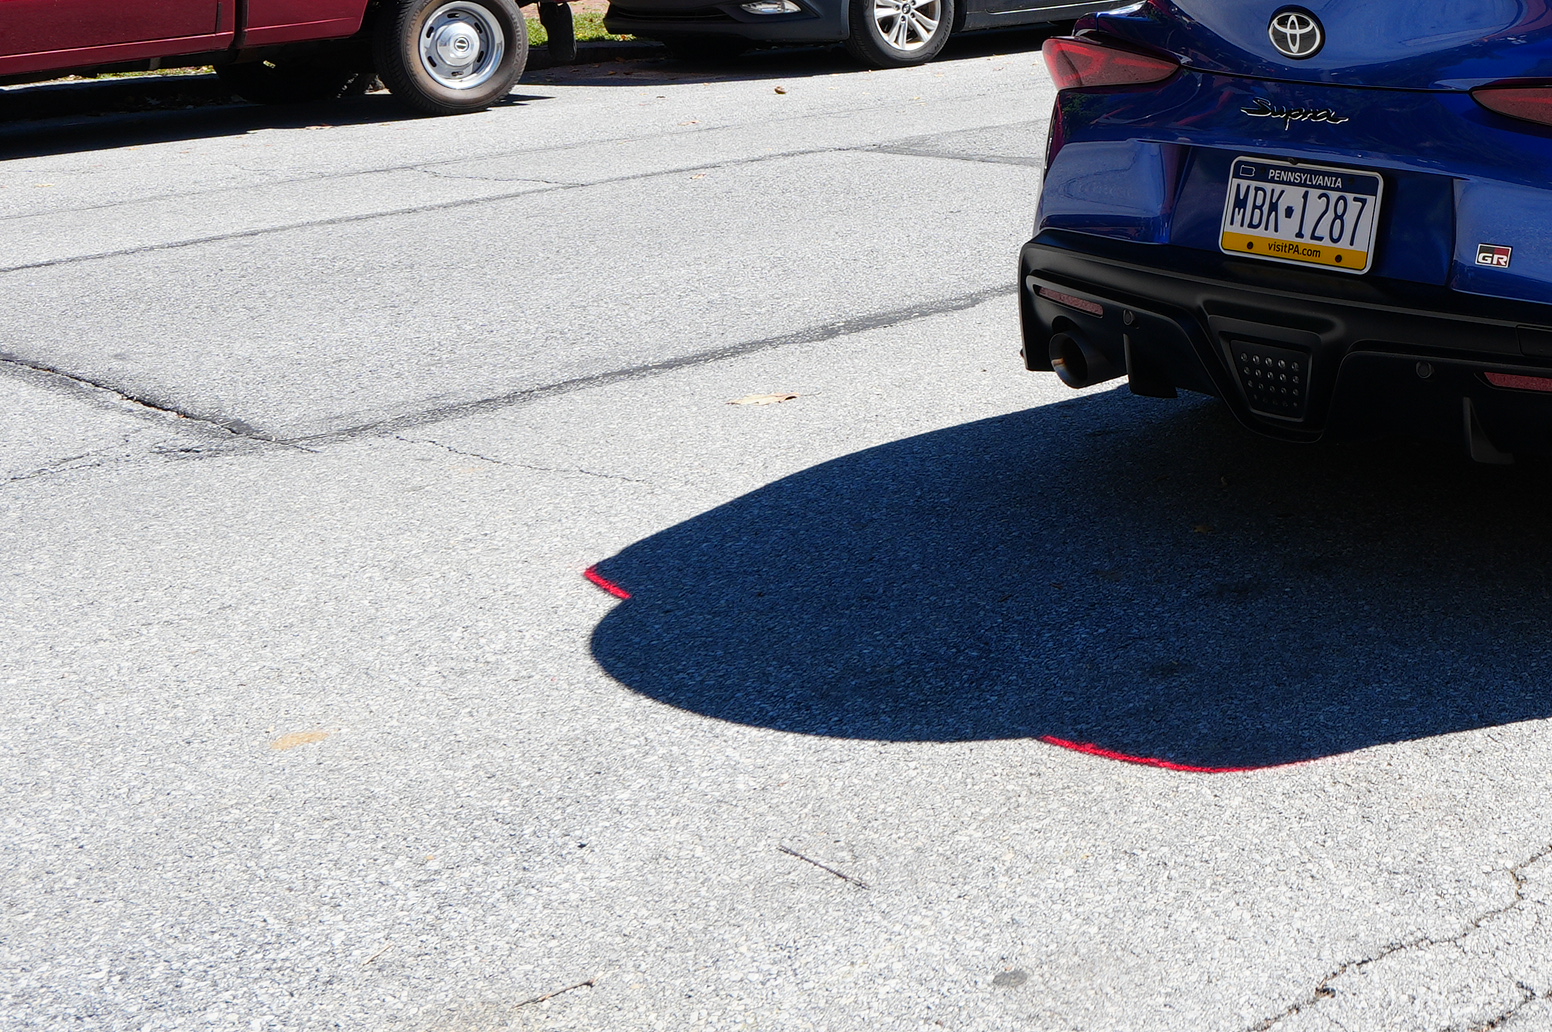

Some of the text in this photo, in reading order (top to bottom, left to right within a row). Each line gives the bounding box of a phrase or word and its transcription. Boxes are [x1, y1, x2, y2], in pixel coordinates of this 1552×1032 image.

[1240, 96, 1349, 131] Supra
[1268, 169, 1343, 189] PENNSYLVANIA
[1229, 182, 1368, 247] MBK 1287
[1267, 241, 1321, 258] visitPA.com
[1478, 252, 1508, 266] GR
